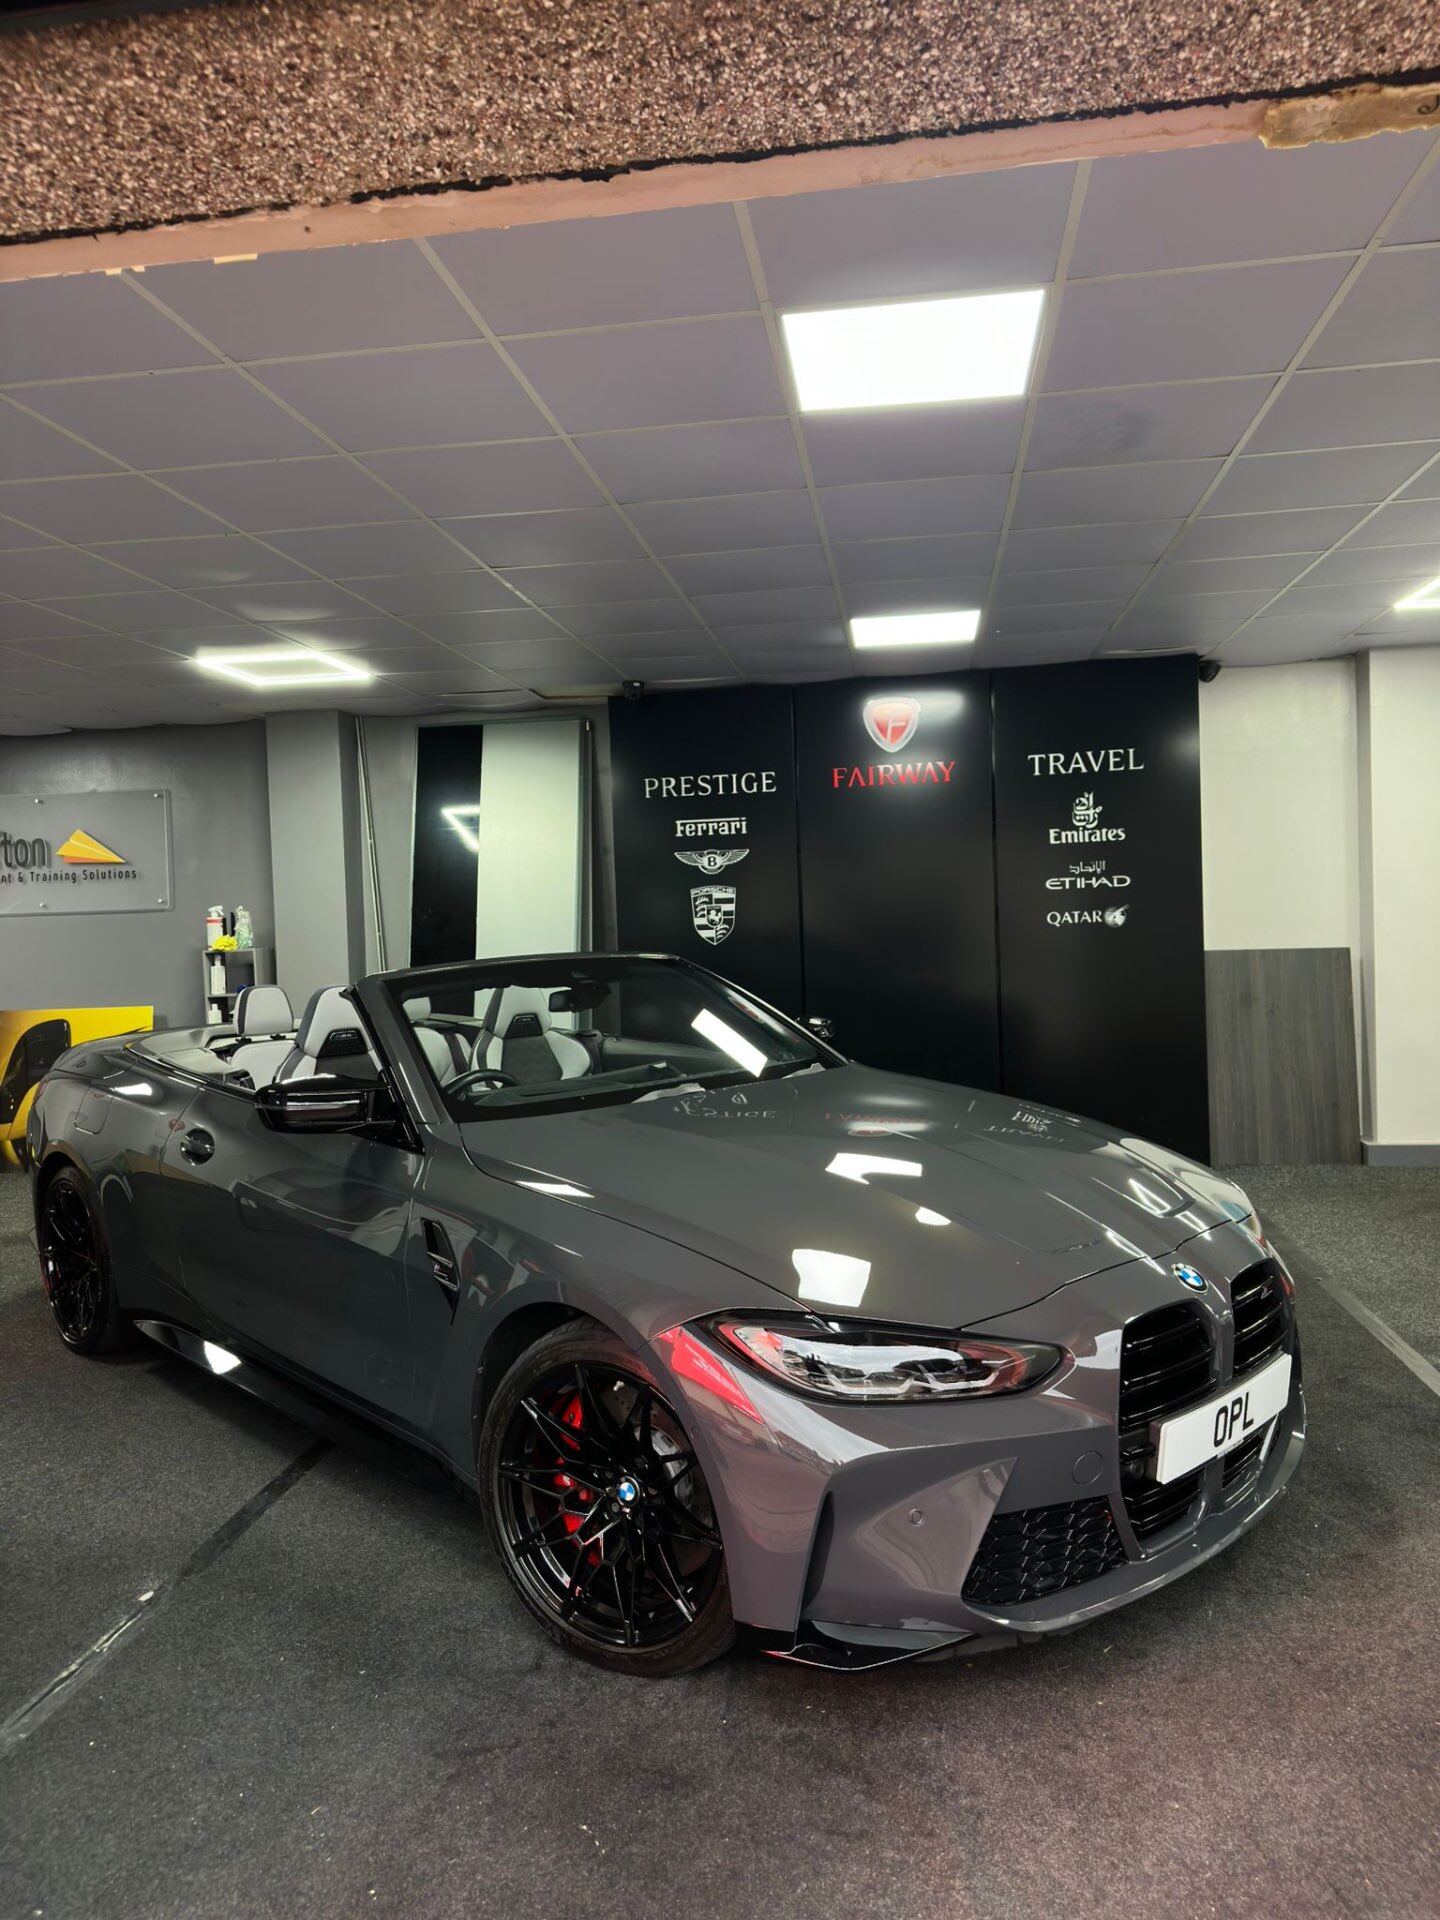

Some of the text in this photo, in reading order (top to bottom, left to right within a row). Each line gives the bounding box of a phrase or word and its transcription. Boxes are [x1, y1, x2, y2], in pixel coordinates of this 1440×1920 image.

[1028, 748, 1144, 776] TRAVEL
[832, 761, 955, 788] FAIRWAY
[645, 772, 776, 798] PRESTIGE
[675, 817, 747, 837] Ferrari
[1049, 827, 1125, 844] Emirates
[18, 872, 23, 882] &
[30, 871, 77, 884] Training
[83, 869, 137, 880] Solutions
[1045, 875, 1131, 890] ETIHAD
[1047, 910, 1102, 927] QATAR
